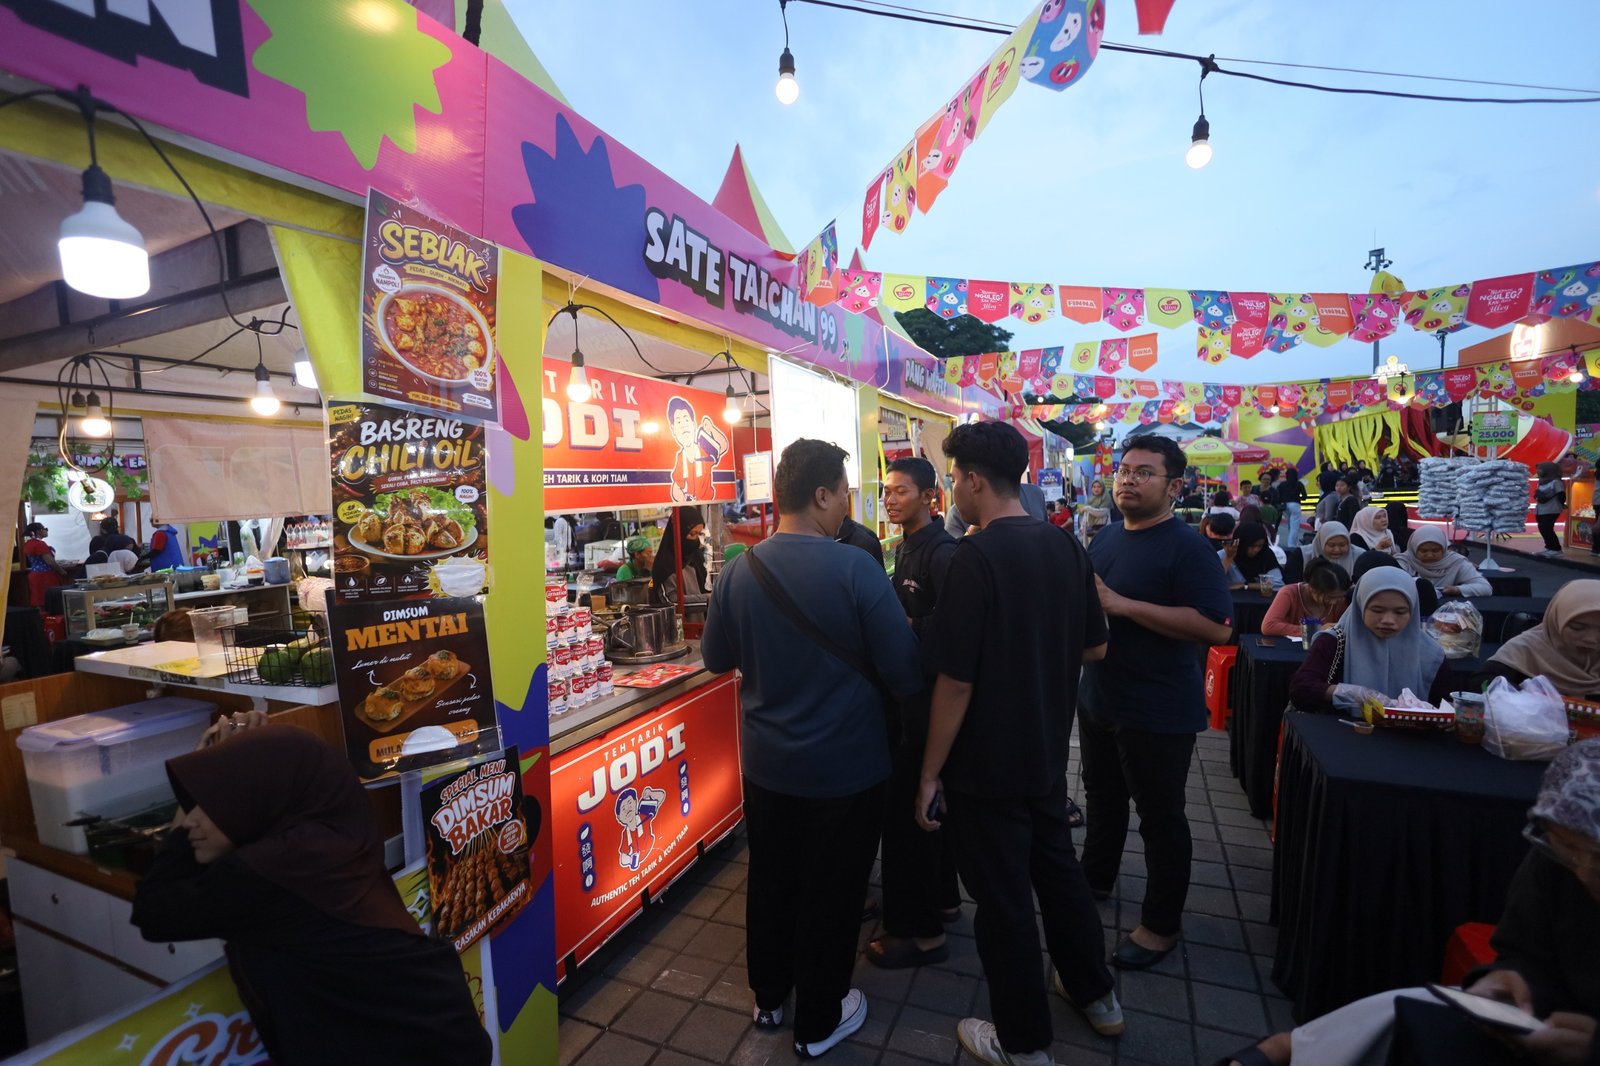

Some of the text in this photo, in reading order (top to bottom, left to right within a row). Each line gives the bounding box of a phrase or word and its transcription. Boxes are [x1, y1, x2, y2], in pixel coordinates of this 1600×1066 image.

[380, 222, 487, 290] SEBLAK
[409, 265, 425, 274] PEDAS
[376, 278, 400, 288] NAMPOL!
[645, 211, 836, 345] SATE TAICHAN 99
[974, 293, 1004, 302] NGULEG?
[1480, 288, 1523, 300] NGULEG?
[1320, 308, 1347, 316] FINNA
[1133, 348, 1152, 356] FINNA
[545, 370, 639, 405] TRIK
[333, 408, 352, 416] PEDAS
[335, 413, 354, 422] NAGIH!
[543, 398, 643, 452] ODI
[360, 418, 464, 445] BASRENG
[1479, 430, 1515, 438] 25.000
[544, 474, 555, 484] EH
[557, 474, 581, 484] TARIK
[592, 474, 609, 482] KOPI
[610, 474, 628, 482] TIAM
[383, 606, 428, 622] DIMSUM
[344, 612, 468, 651] MENTAI
[376, 745, 402, 757] MULA
[604, 723, 664, 761] TEH TARIK
[577, 722, 686, 812] JODI
[441, 759, 506, 804] SPECIAL MENU
[434, 774, 514, 836] DIMSUM
[446, 799, 512, 854] BAKAR
[591, 881, 628, 908] AUTHENTIC
[629, 874, 640, 888] TEH
[640, 862, 658, 880] TARIK
[663, 840, 676, 856] KOPI
[676, 825, 688, 843] TIAM
[454, 882, 526, 952] RASAKAN KEBAKARNYA
